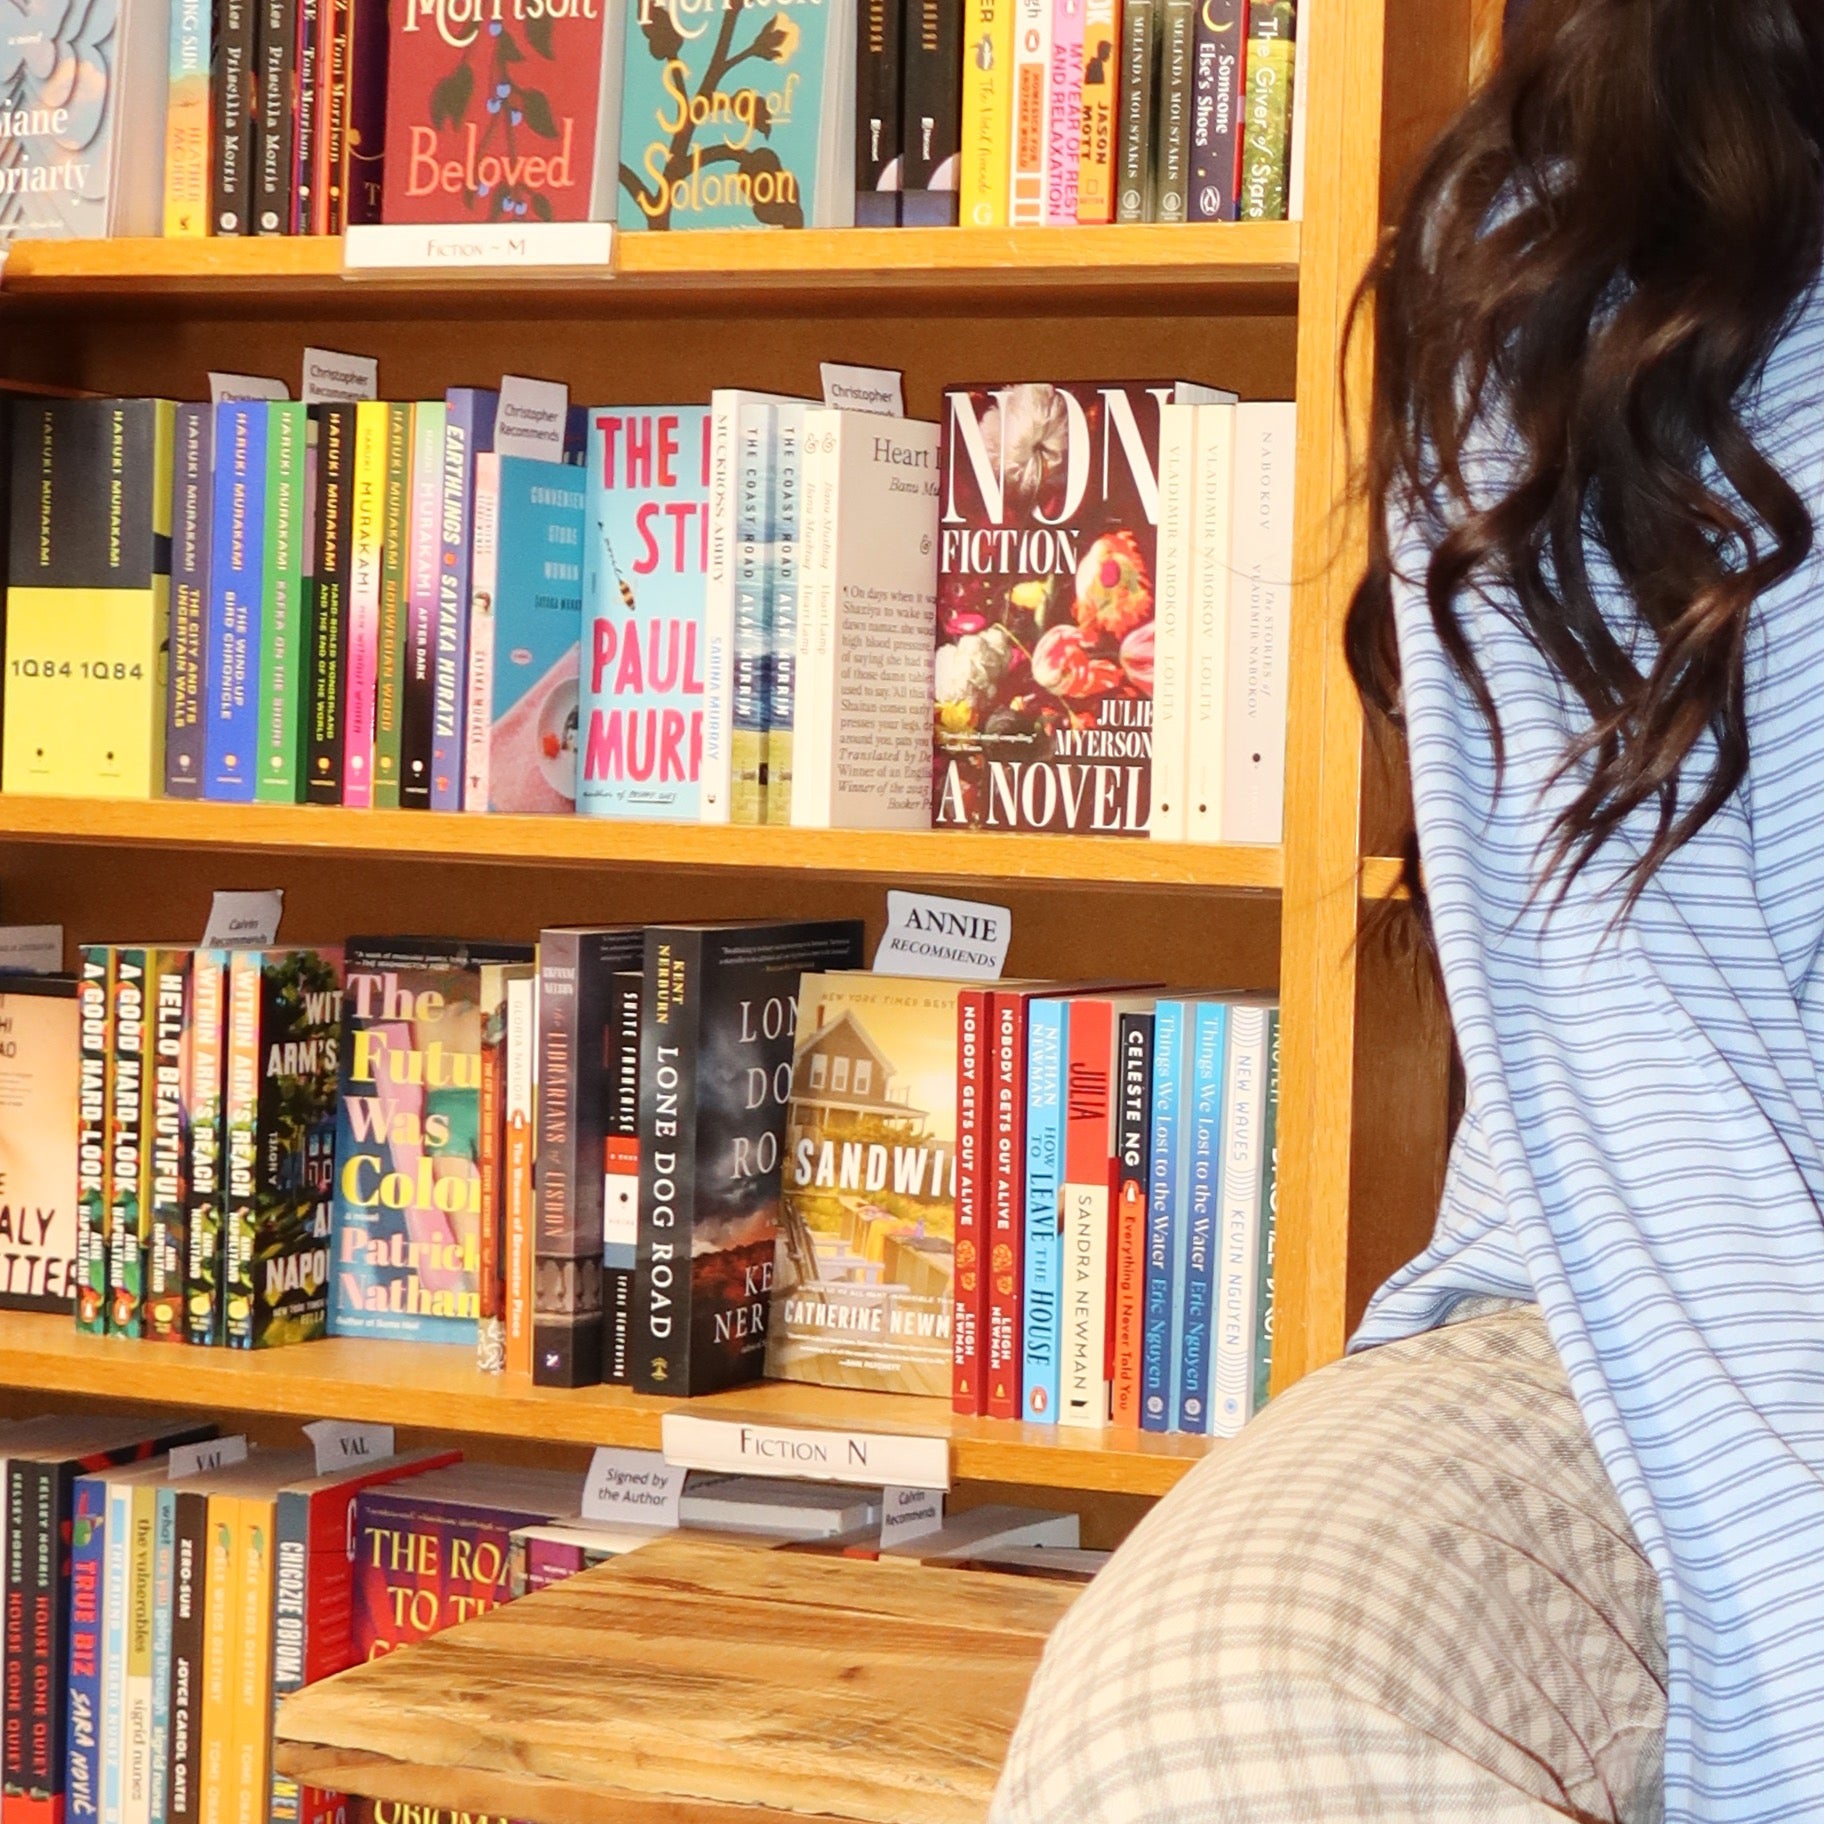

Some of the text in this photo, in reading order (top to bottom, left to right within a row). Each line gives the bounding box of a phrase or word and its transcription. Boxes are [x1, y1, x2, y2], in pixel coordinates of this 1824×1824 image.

[657, 61, 799, 148] Song of
[406, 118, 574, 197] Beloved
[639, 143, 797, 217] Solomon
[507, 240, 526, 257] M
[500, 421, 560, 443] Recommends
[504, 404, 559, 423] Christopher
[596, 417, 679, 489] THE
[940, 528, 1080, 576] FICTION
[435, 425, 464, 738] EARTHLINGS SAYAKA MURATA
[12, 660, 72, 679] 1Q84
[81, 661, 143, 680] 1Q84
[592, 617, 704, 695] PAUL
[1054, 728, 1154, 758] MYERSON
[936, 758, 1150, 830] A NOVEL
[904, 907, 998, 943] ANNIE
[890, 938, 997, 969] RECOMMENDS
[347, 973, 444, 1022] The
[153, 974, 182, 1208] HELLO BEAUTIFUL
[1070, 1063, 1104, 1122] JULIA
[346, 1099, 451, 1147] Was
[650, 1047, 679, 1339] LONE DOG ROAD
[1072, 1195, 1093, 1389] SANDRA NEWMAN
[783, 1301, 882, 1331] CATHERINE
[340, 1436, 370, 1456] VAL
[848, 1440, 868, 1466] N
[599, 1487, 667, 1506] the Author
[606, 1468, 667, 1488] Signed by
[365, 1529, 436, 1576] THE
